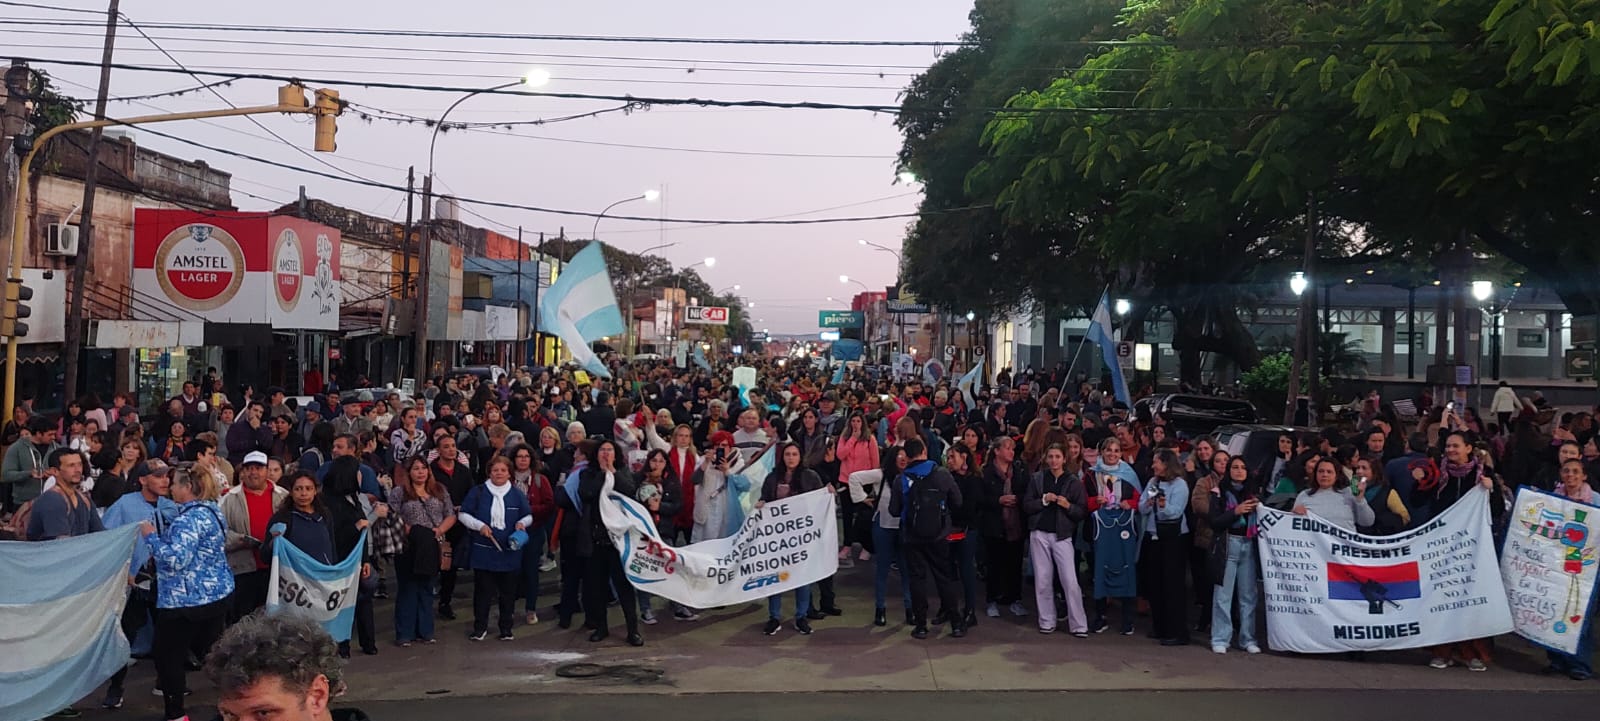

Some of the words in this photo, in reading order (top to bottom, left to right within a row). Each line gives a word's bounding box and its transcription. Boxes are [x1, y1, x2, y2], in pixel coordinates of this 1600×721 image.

[173, 255, 227, 269] AMSTEL
[279, 258, 298, 272] AMSTEL
[181, 273, 218, 282] LAGER
[281, 276, 295, 285] LAGER
[824, 313, 855, 325] piero
[1120, 345, 1127, 355] E
[770, 504, 790, 517] DE
[1266, 537, 1316, 548] MIENTRAS
[1427, 537, 1448, 549] POR
[1270, 549, 1311, 559] EXISTAN
[1331, 543, 1411, 559] PRESENTE
[1452, 551, 1473, 561] NOS
[718, 570, 735, 585] DE
[740, 550, 808, 577] MISIONES
[1267, 560, 1318, 571] DOCENTES
[1304, 574, 1318, 582] NO
[278, 576, 313, 609] ESC.
[1277, 582, 1309, 592] HABRÁ
[1265, 593, 1307, 604] PUEBLOS
[1310, 597, 1324, 605] DE
[1443, 590, 1460, 598] NO
[1430, 596, 1489, 613] OBEDECER
[1333, 622, 1421, 640] MISIONES
